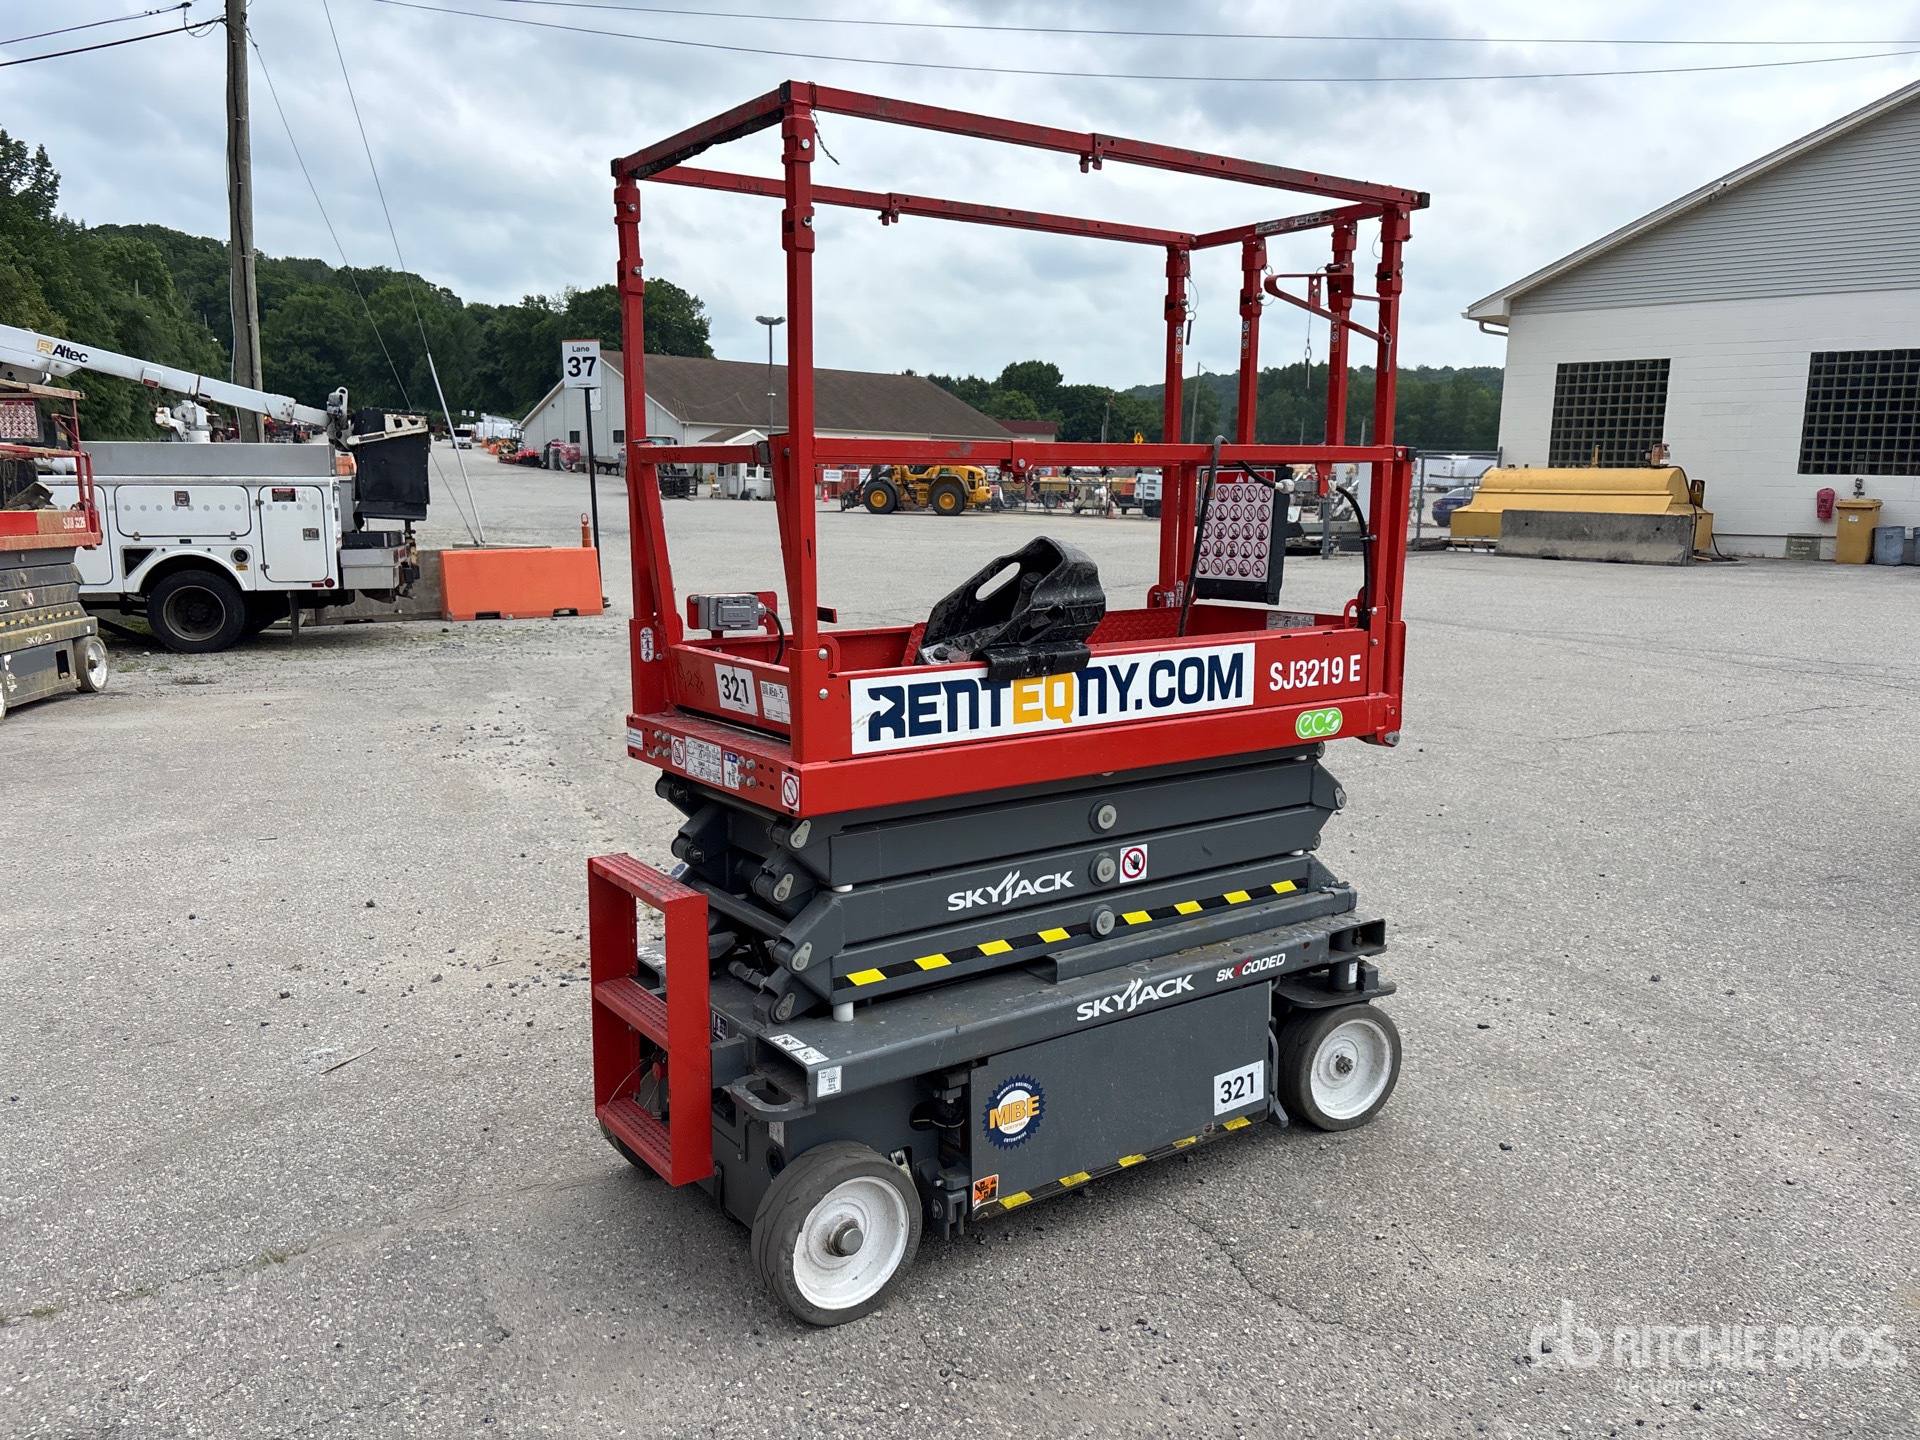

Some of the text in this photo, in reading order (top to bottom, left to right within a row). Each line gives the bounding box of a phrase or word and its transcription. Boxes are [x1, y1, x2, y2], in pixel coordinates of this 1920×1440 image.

[52, 344, 89, 363] Altec
[568, 356, 597, 377] 37
[720, 673, 750, 704] 321
[1269, 654, 1361, 691] SJ3219 E
[947, 870, 1075, 911] SKYJACK
[1216, 953, 1286, 982] SKYCODED
[1076, 978, 1195, 1021] SKYJACK
[1220, 1072, 1254, 1104] 321
[989, 1095, 1040, 1130] MBE
